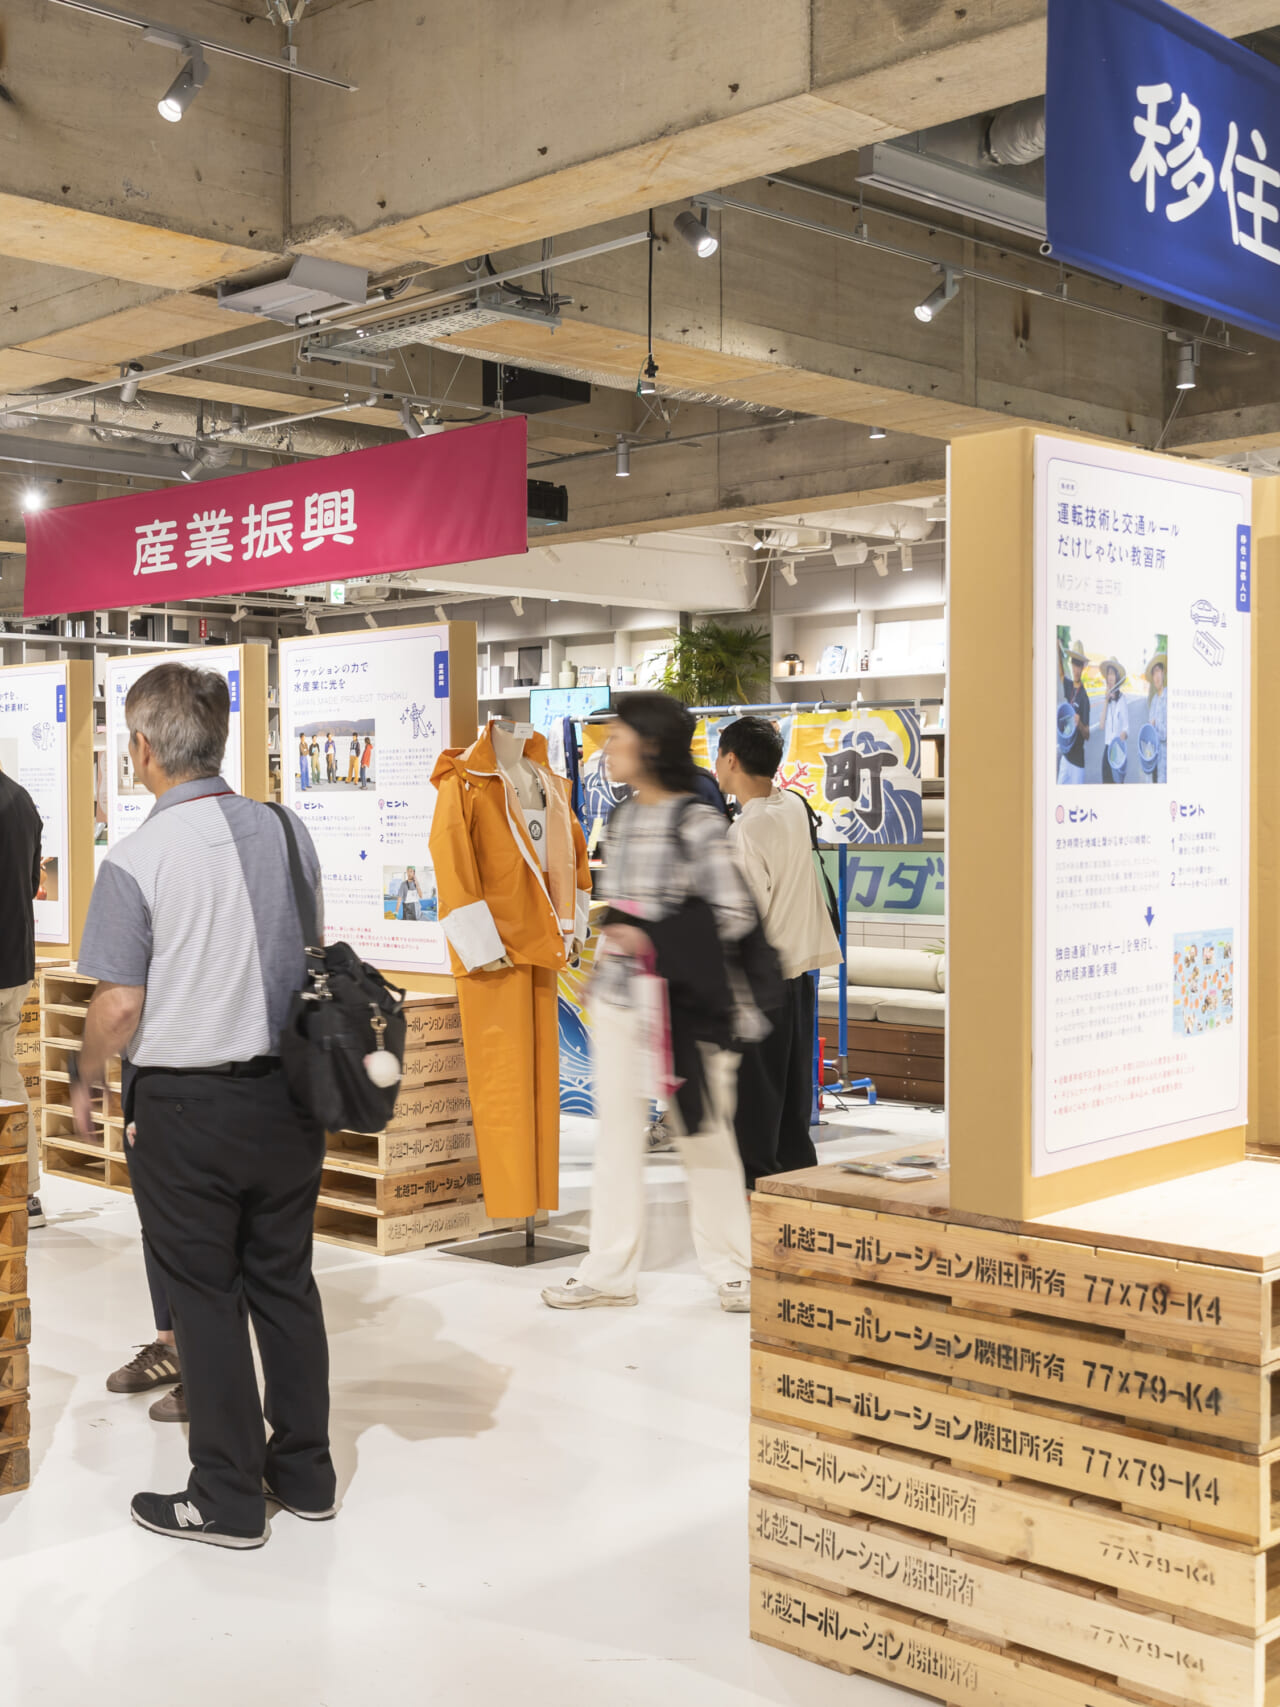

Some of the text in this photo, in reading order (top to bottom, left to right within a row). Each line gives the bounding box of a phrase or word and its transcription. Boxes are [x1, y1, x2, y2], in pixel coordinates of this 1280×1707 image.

[1130, 82, 1280, 266] 移住
[133, 488, 358, 576] 産業振興
[1057, 502, 1180, 536] 運転技術と交通ルール
[1057, 534, 1166, 569] だけじゃない教習所
[294, 662, 369, 677] ファッションの力で
[294, 678, 346, 693] 水産業に光を
[823, 748, 898, 832] 町
[1179, 803, 1205, 818] ヒント
[837, 856, 944, 909] カダ
